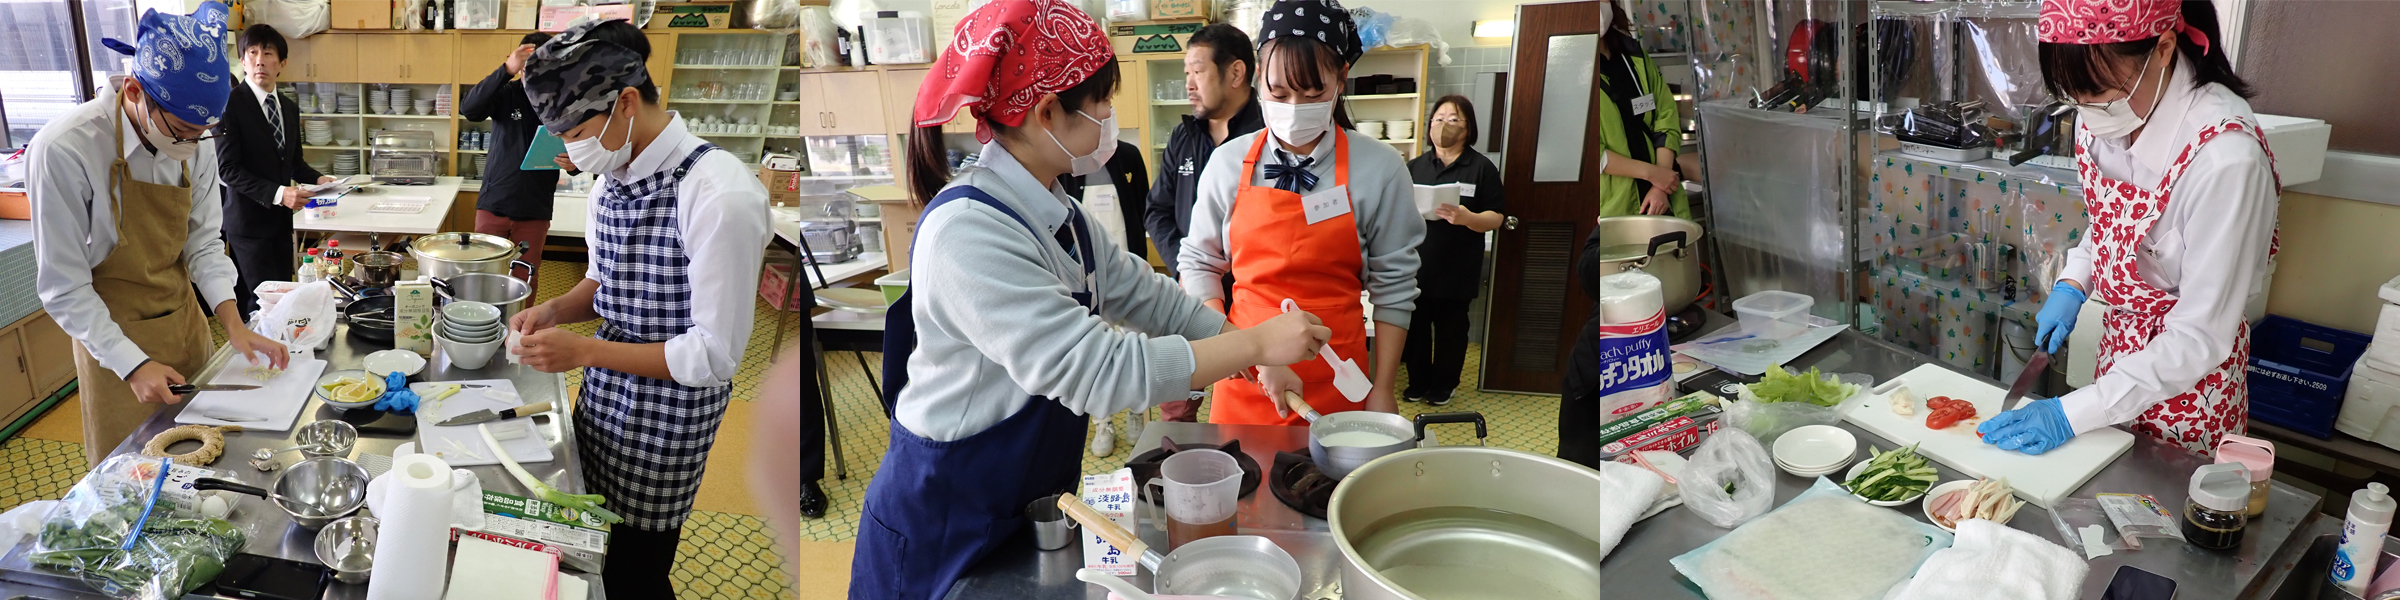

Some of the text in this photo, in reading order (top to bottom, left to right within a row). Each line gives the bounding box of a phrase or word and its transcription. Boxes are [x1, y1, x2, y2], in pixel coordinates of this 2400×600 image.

[1632, 321, 1659, 334] エリエール
[1600, 338, 1651, 360] ach puffy
[1098, 492, 1130, 503] 淡路島
[1107, 503, 1121, 511] 牛乳
[1101, 556, 1118, 564] 牛乳
